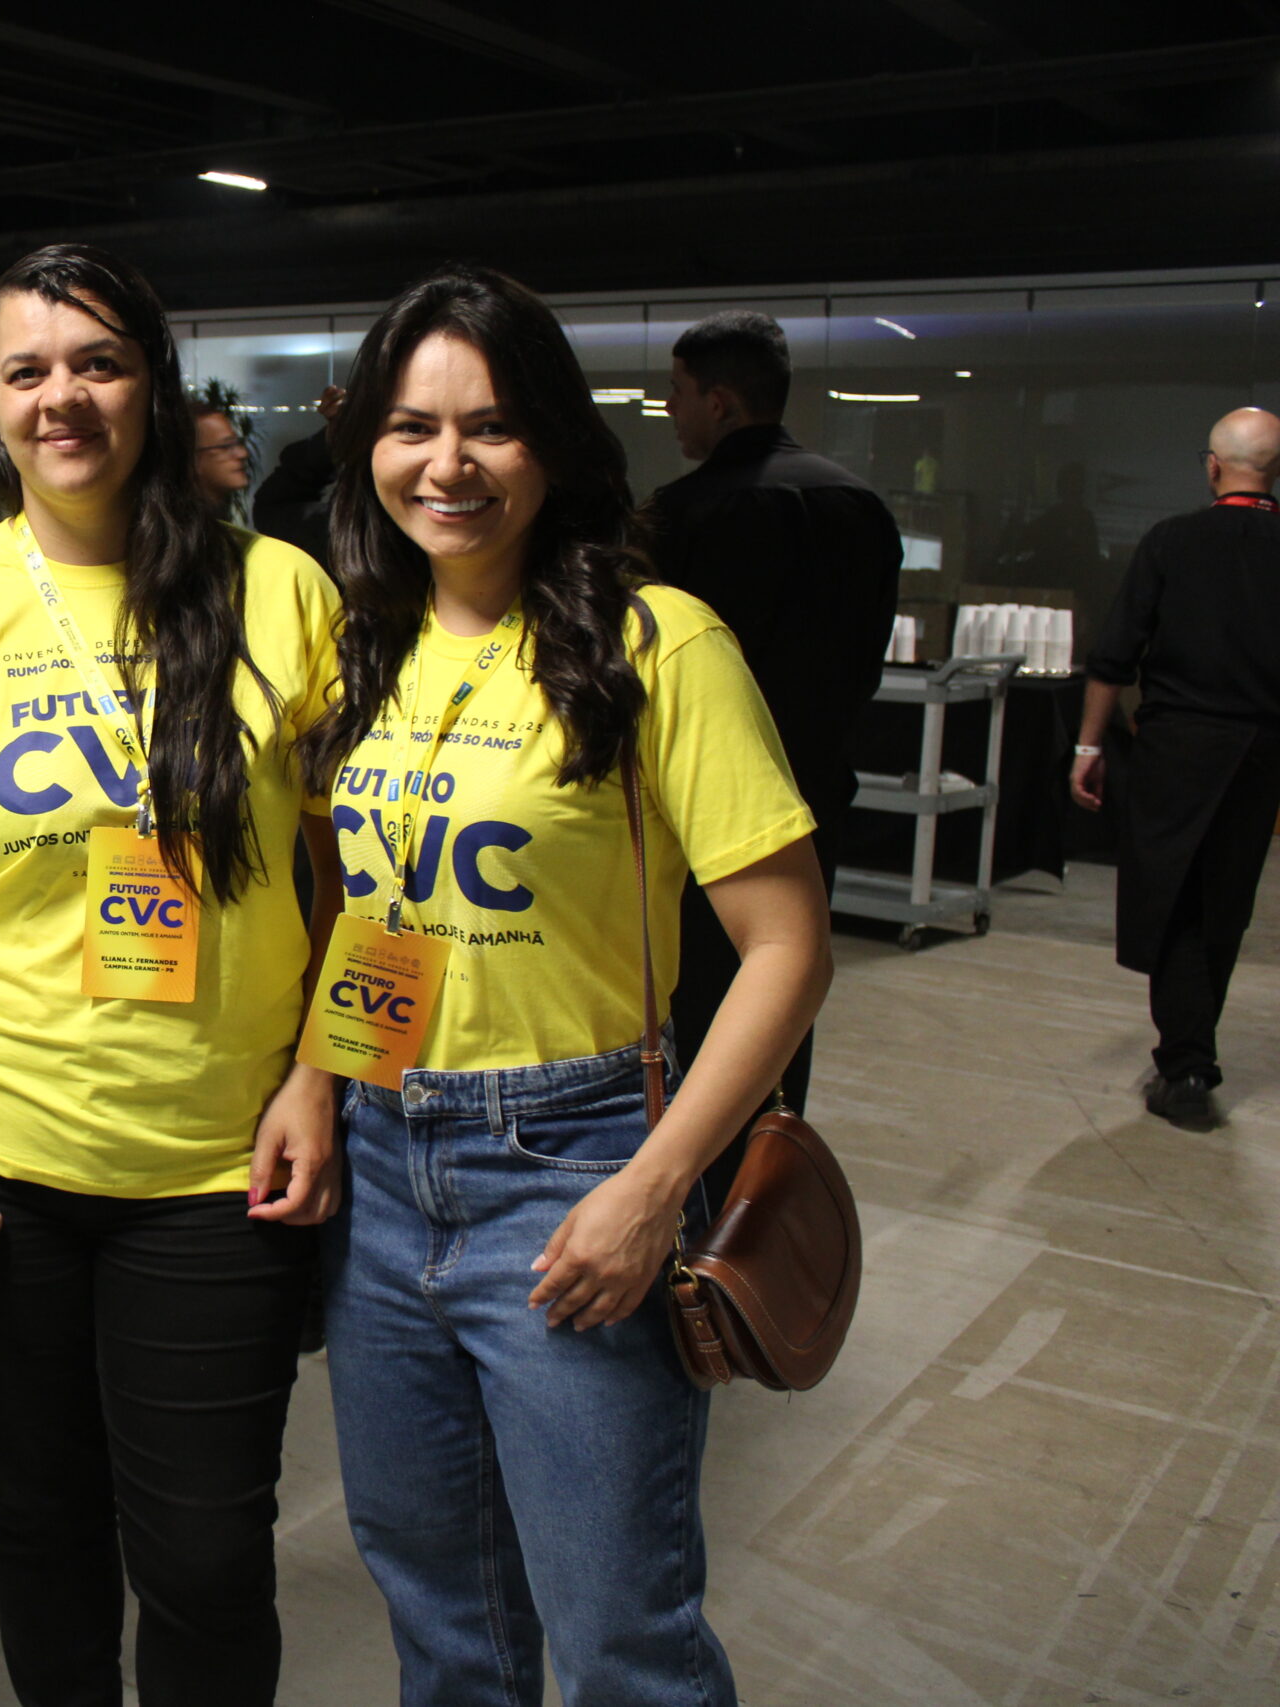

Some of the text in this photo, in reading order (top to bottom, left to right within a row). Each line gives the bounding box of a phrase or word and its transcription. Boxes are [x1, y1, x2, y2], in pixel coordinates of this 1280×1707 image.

[478, 642, 502, 670] CVC
[7, 663, 48, 678] RUMO
[11, 687, 150, 728] FUTUR
[452, 716, 500, 730] ENDAS
[508, 722, 544, 734] 225
[115, 728, 135, 755] CVC
[462, 734, 480, 746] 50
[3, 832, 59, 855] JUNTOS
[331, 804, 534, 913] CVC
[109, 883, 160, 895] FUTURO
[100, 896, 184, 928] CVC
[468, 930, 545, 947] AMANHÃ
[136, 957, 178, 966] FERNANDES
[343, 968, 396, 990] FUTURO
[329, 980, 416, 1024] CVC
